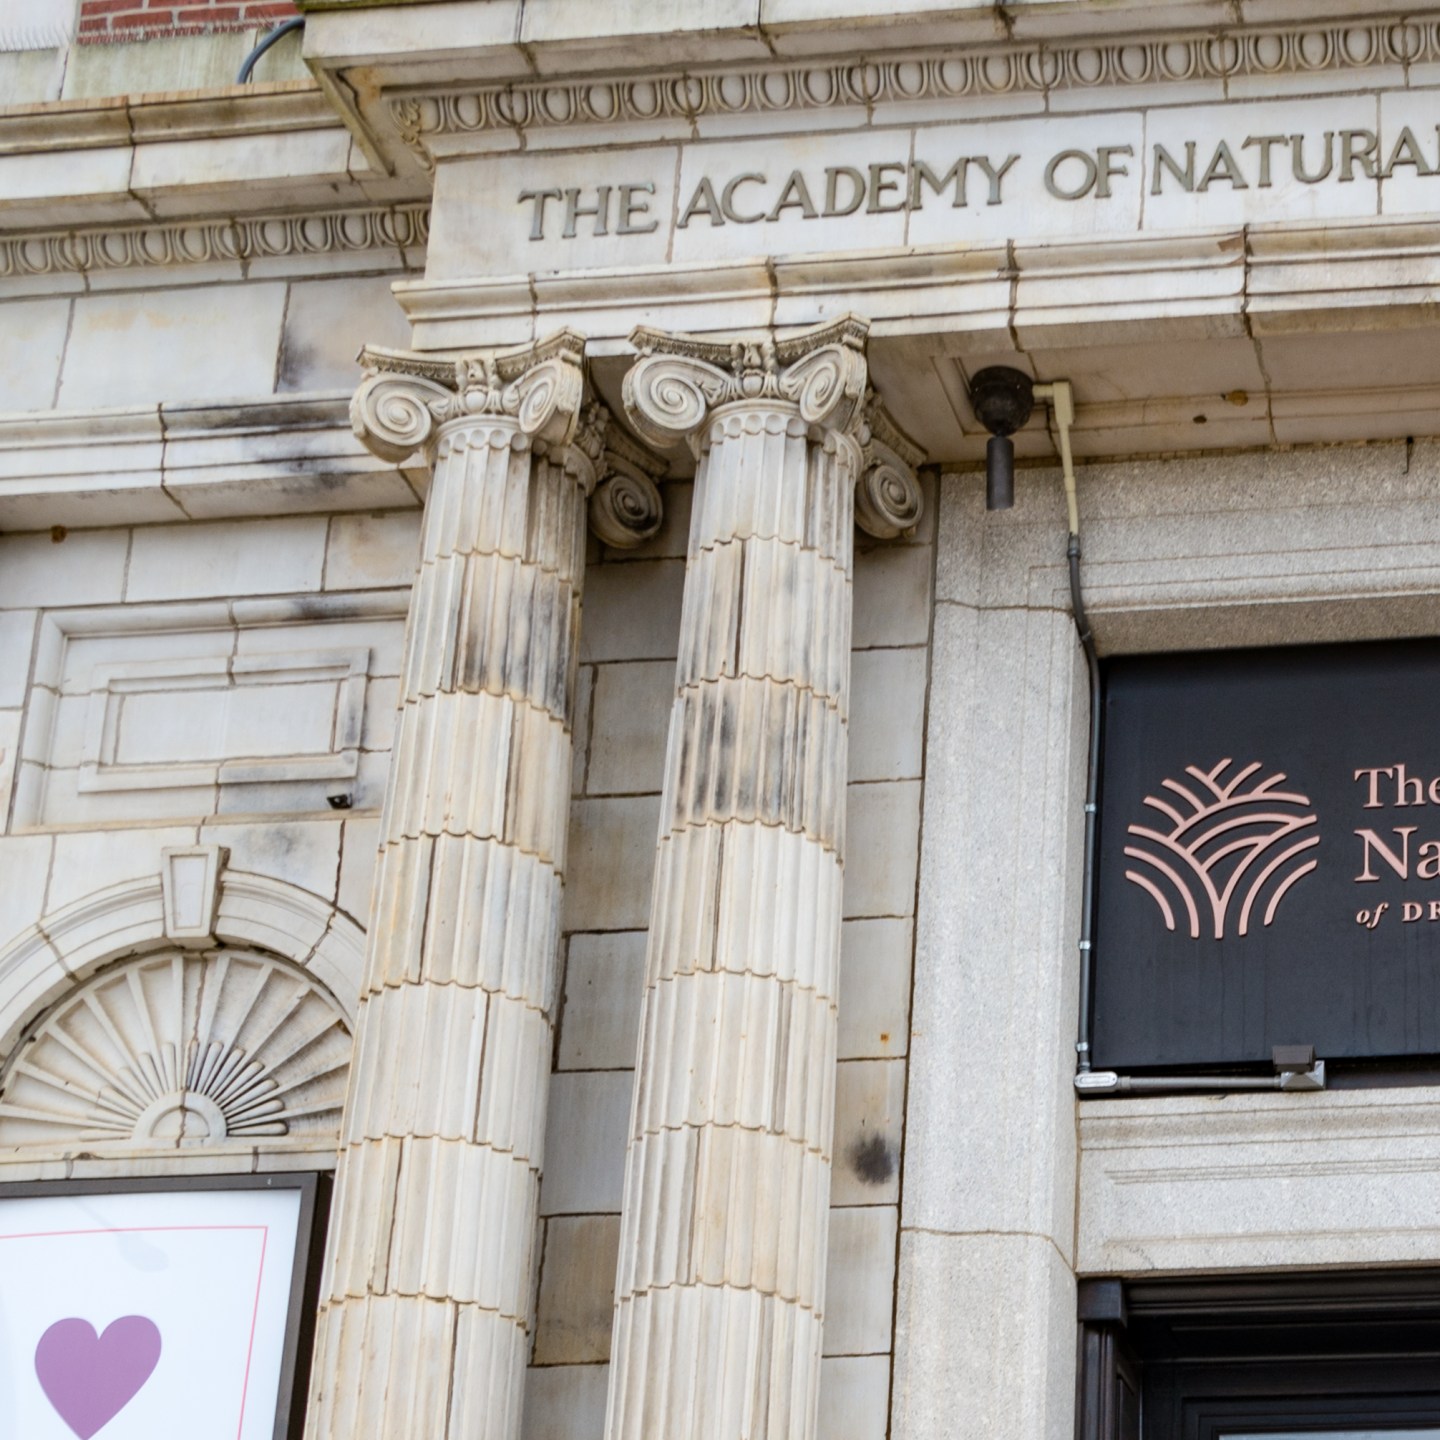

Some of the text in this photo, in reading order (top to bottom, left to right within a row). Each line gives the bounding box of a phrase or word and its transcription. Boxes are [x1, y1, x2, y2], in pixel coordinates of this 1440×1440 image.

[518, 181, 658, 241] THE
[677, 154, 1021, 229] ACADEMY
[1044, 143, 1134, 200] OF
[1356, 902, 1389, 929] of
